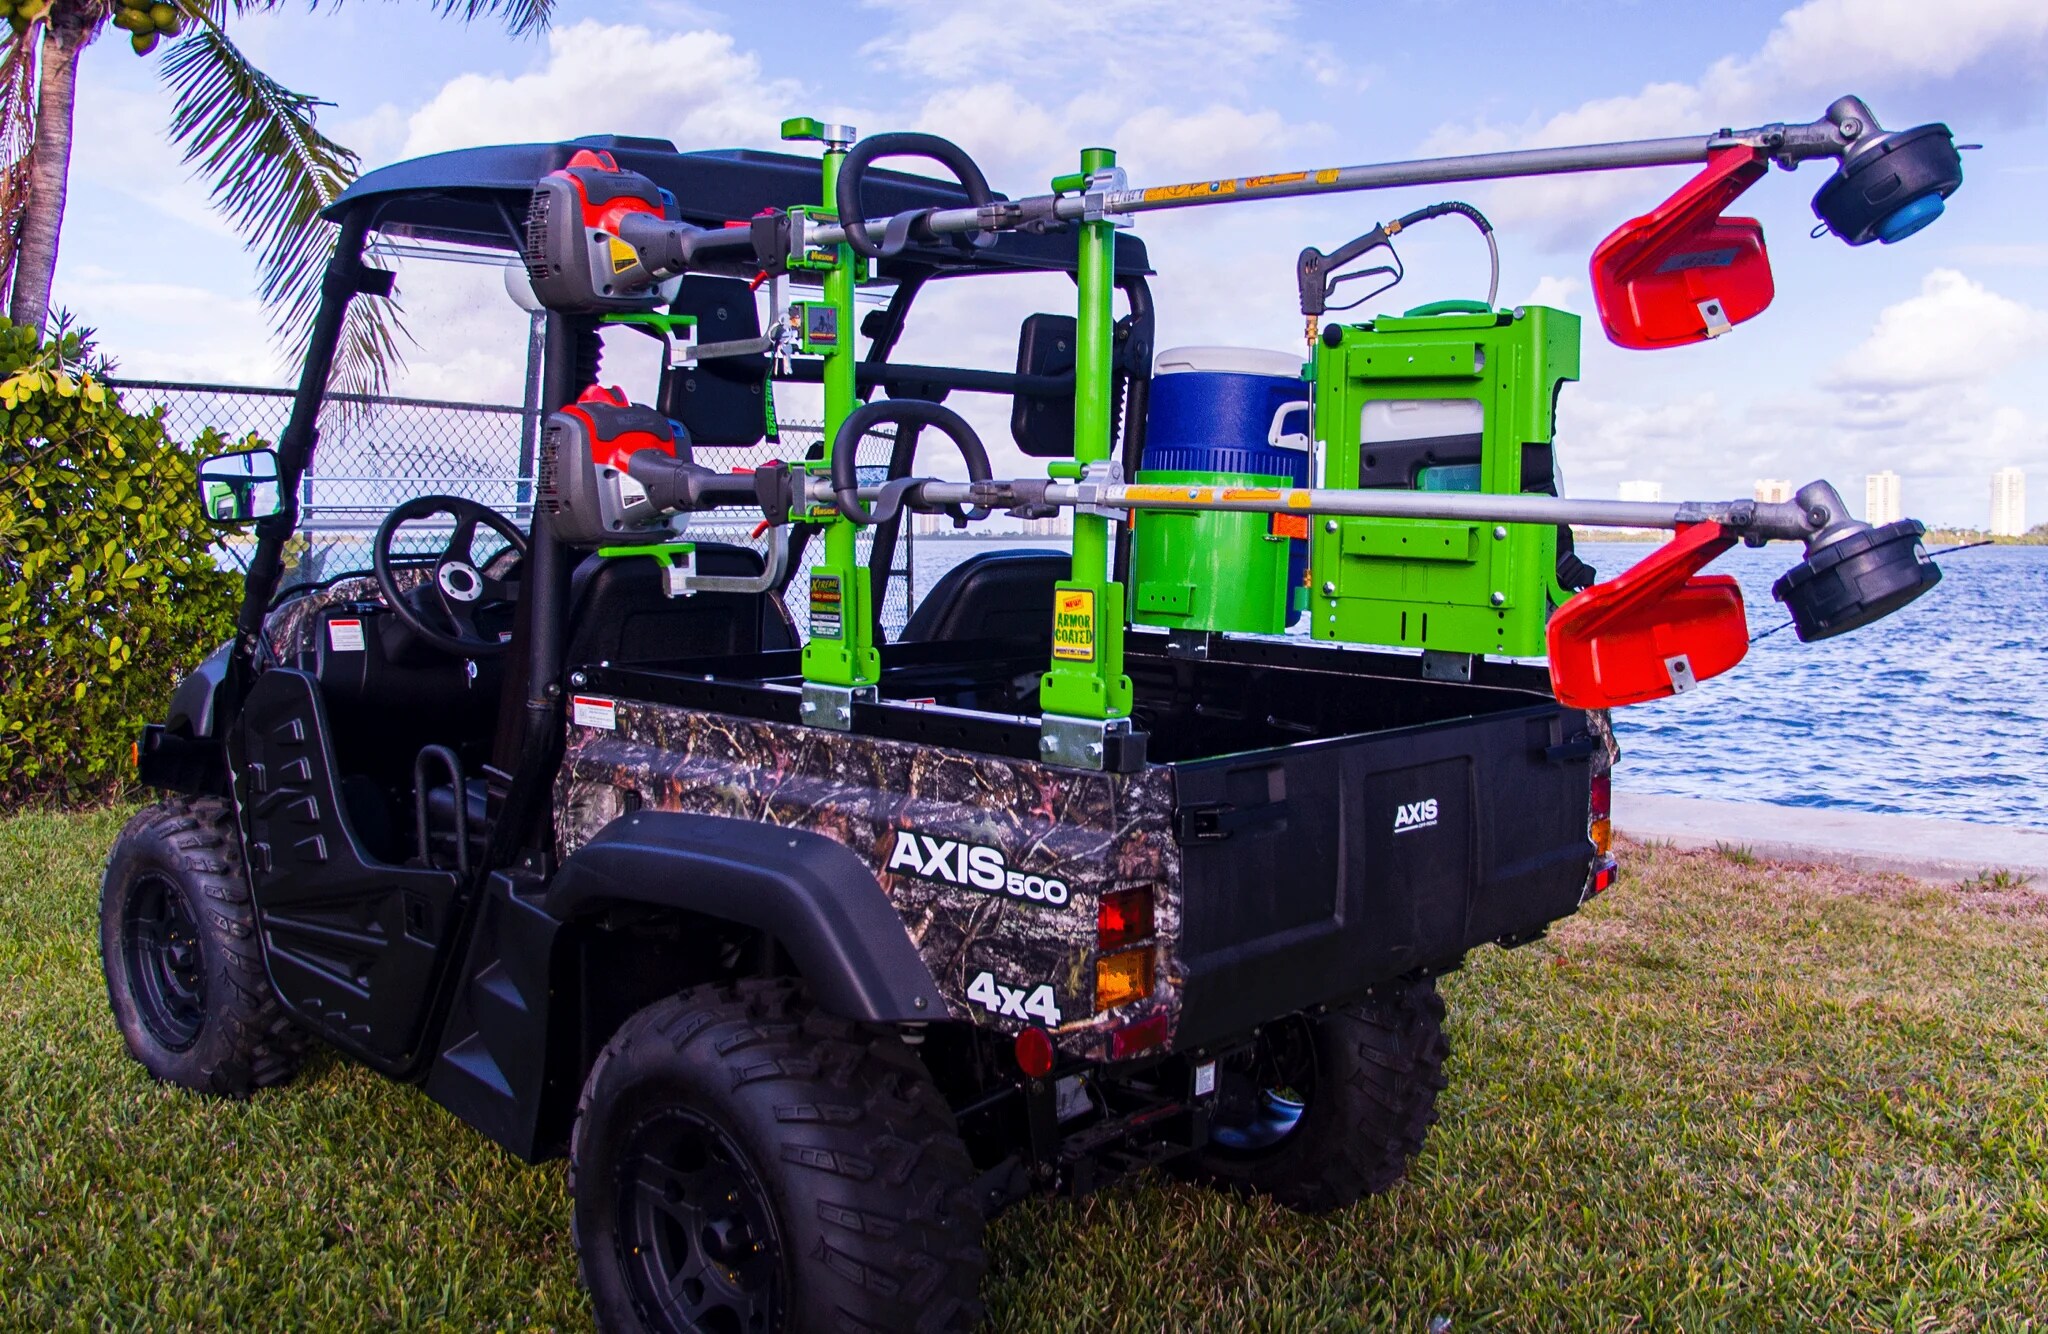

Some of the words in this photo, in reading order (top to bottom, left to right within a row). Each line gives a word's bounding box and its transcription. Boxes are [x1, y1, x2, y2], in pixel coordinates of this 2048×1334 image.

[812, 579, 838, 591] XTREME
[1057, 612, 1091, 628] ARMOR
[1055, 629, 1092, 644] COATED
[1395, 798, 1438, 827] AXIS
[966, 971, 1061, 1026] 4x4
